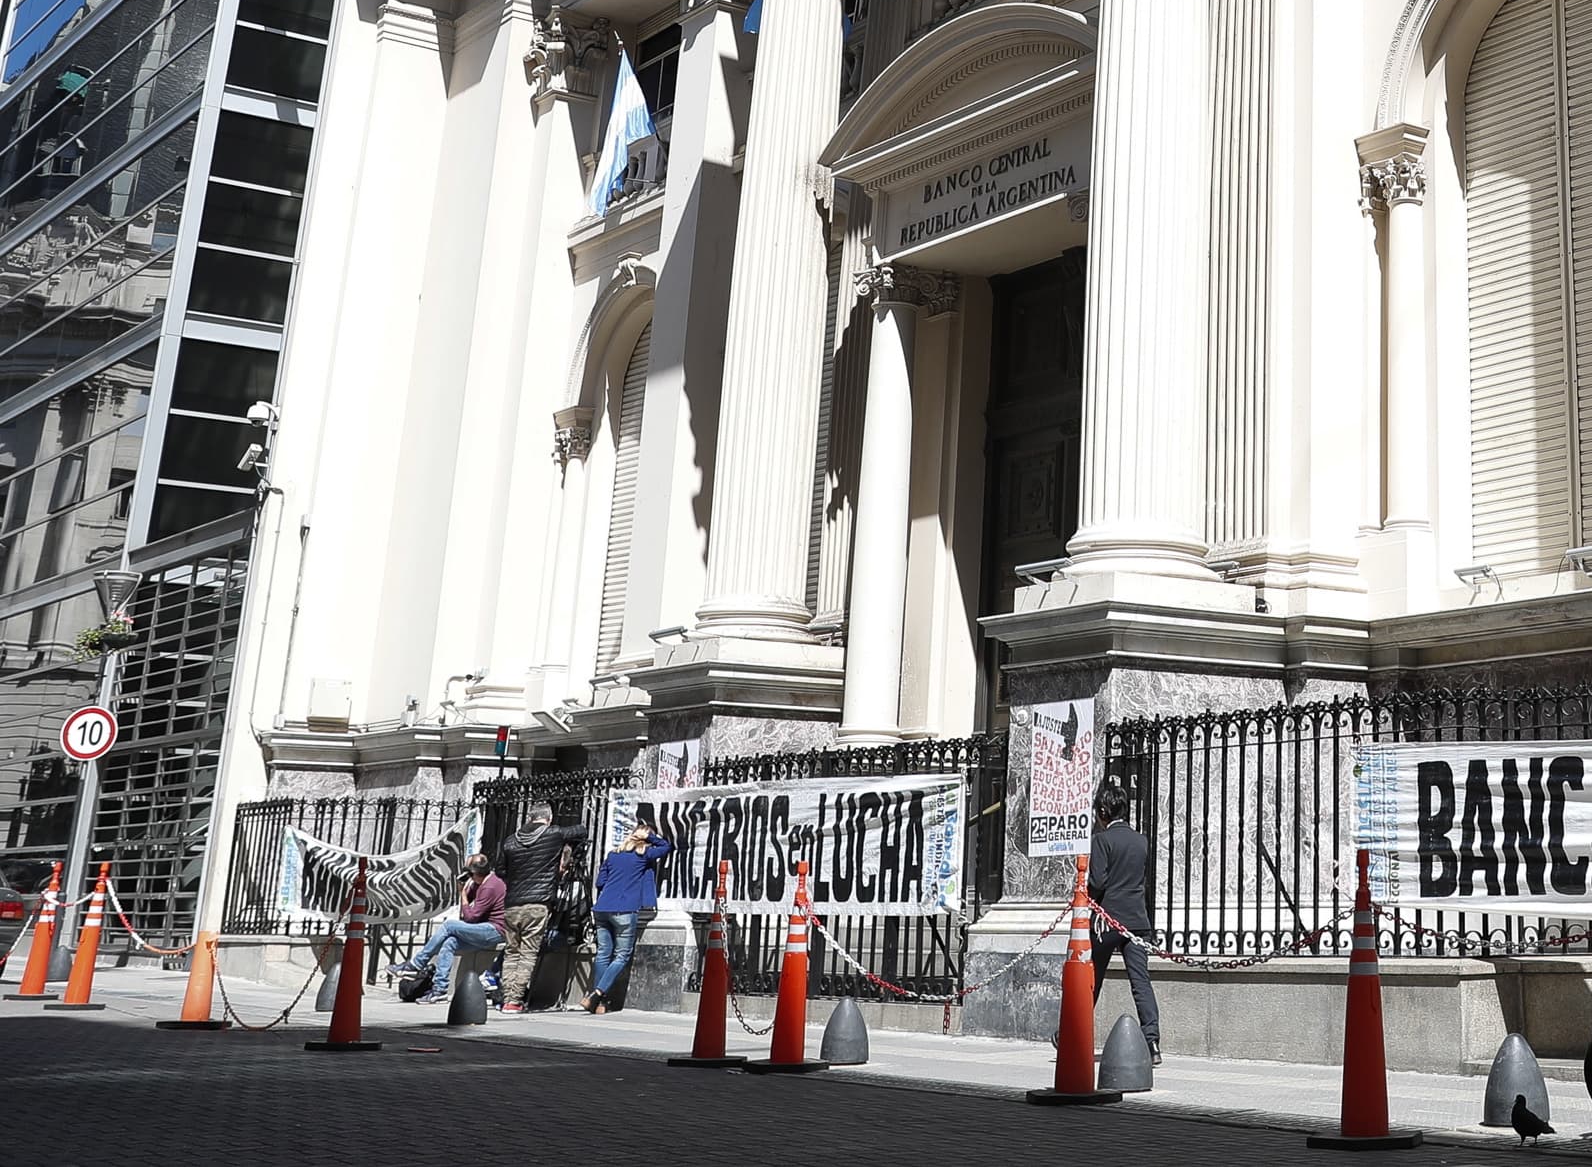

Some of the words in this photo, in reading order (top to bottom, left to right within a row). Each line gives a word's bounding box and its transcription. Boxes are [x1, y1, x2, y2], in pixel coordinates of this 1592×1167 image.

[923, 164, 982, 204] BANCO
[988, 137, 1052, 176] CENTRAL
[971, 186, 984, 198] DE
[985, 181, 997, 195] LA
[899, 201, 979, 246] REPUBLICA
[985, 165, 1077, 216] ARGENTINA
[77, 720, 104, 747] 10
[1034, 751, 1091, 777] SALUD
[1033, 765, 1090, 789] EDUCACION
[1032, 781, 1091, 803] TRABAJO
[1032, 797, 1090, 815] ECONOMIA
[1031, 818, 1047, 838] 25
[1048, 814, 1089, 831] PARO
[788, 822, 815, 877] en
[814, 791, 924, 903] LUCHA
[1048, 830, 1089, 842] GENERAL
